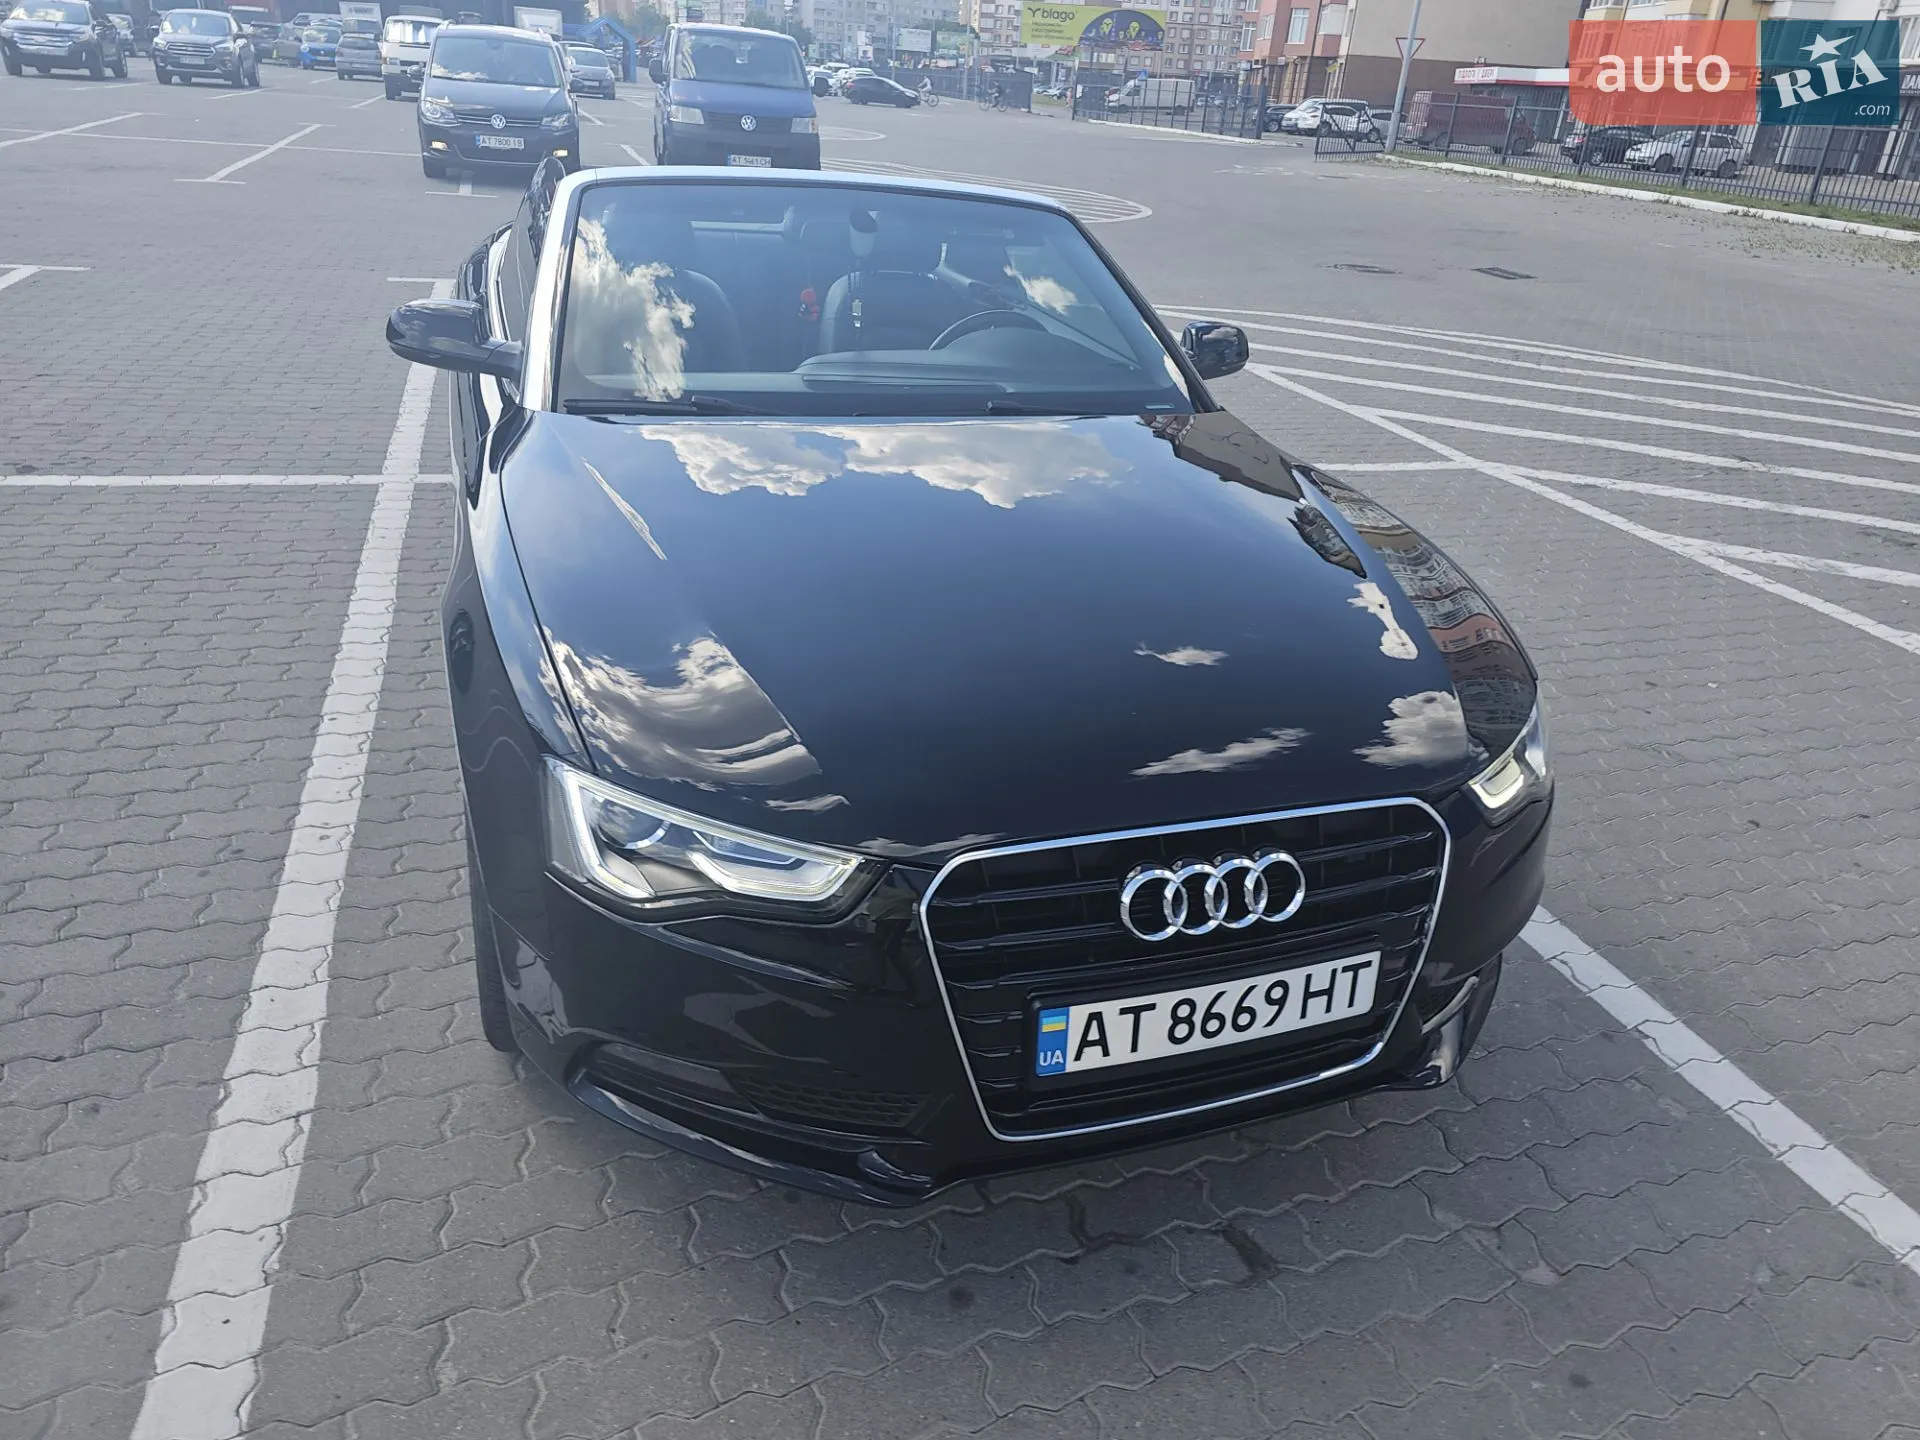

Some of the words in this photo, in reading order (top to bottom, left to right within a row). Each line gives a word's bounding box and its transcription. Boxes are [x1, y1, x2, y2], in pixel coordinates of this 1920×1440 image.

[1041, 8, 1075, 22] blago
[1073, 1002, 1157, 1062] AT
[1167, 979, 1290, 1045] 8669
[1299, 960, 1373, 1020] HT
[1039, 1049, 1065, 1067] UA
